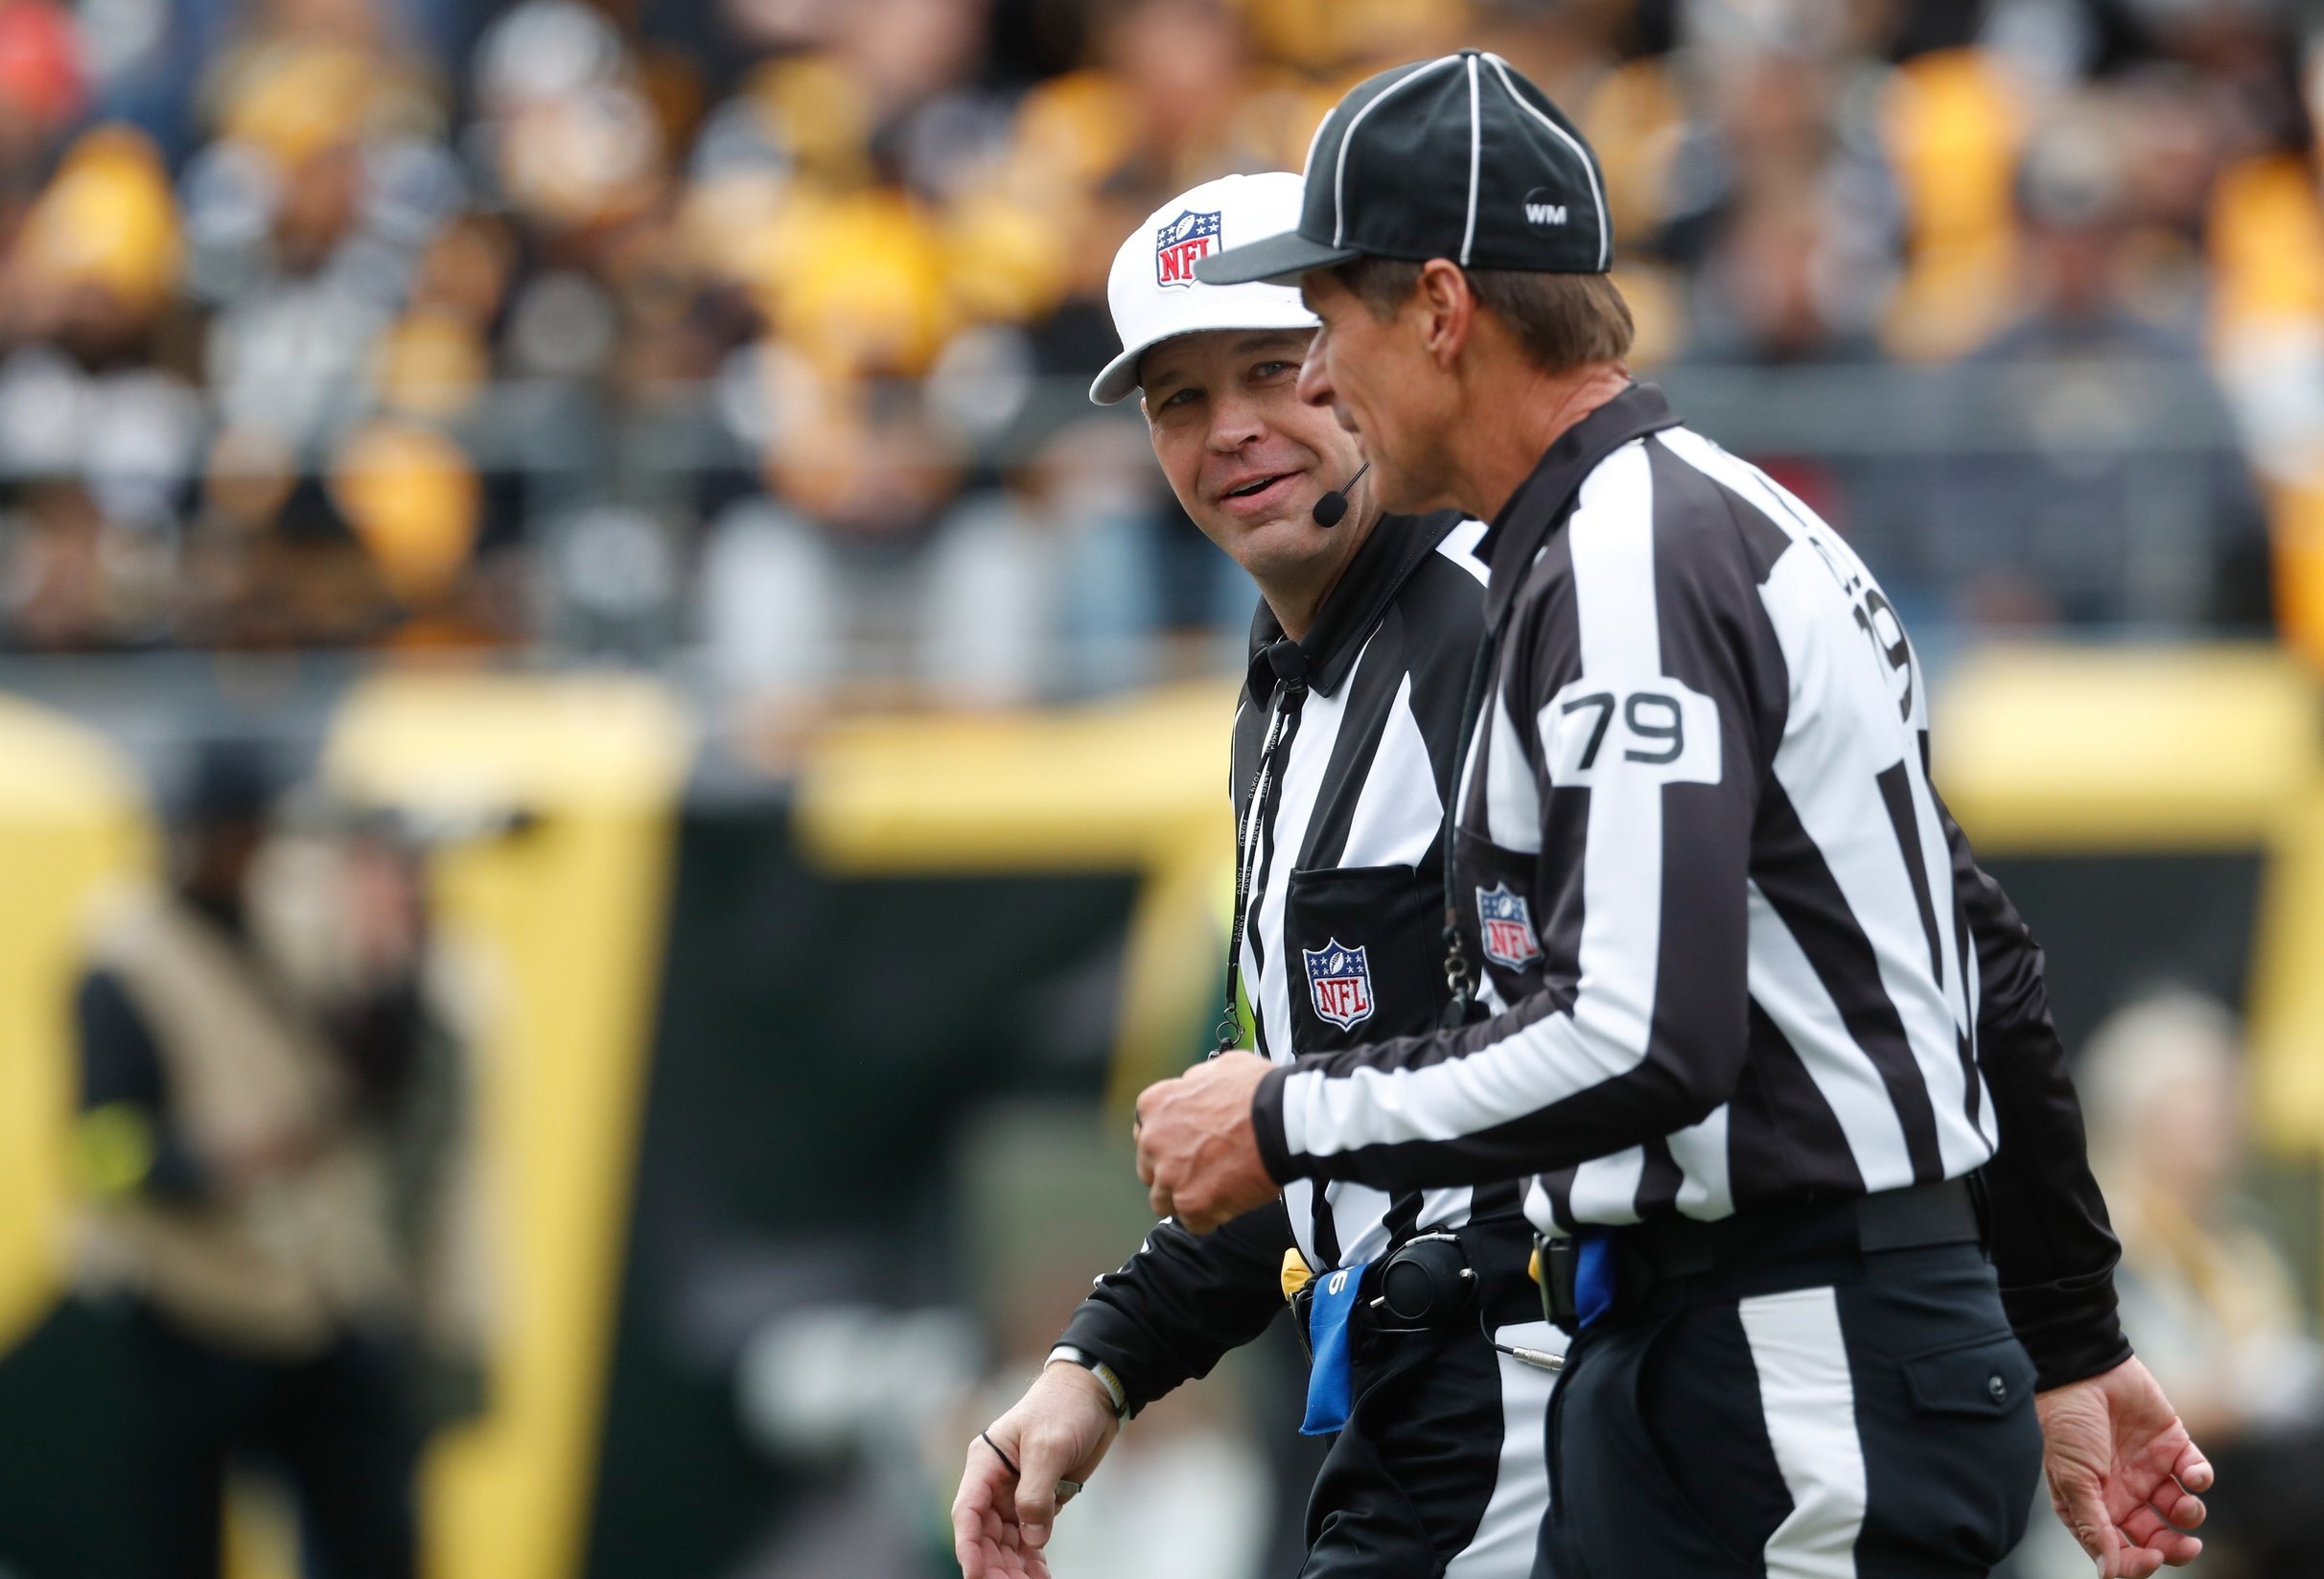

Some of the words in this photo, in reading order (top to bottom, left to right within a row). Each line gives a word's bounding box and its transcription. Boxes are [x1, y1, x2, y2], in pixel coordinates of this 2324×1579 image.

[1525, 203, 1567, 224] WM
[1561, 691, 1685, 771] 79
[1248, 771, 1261, 800] FOX40
[1489, 920, 1539, 961] NFL
[1316, 979, 1367, 1018] NFL
